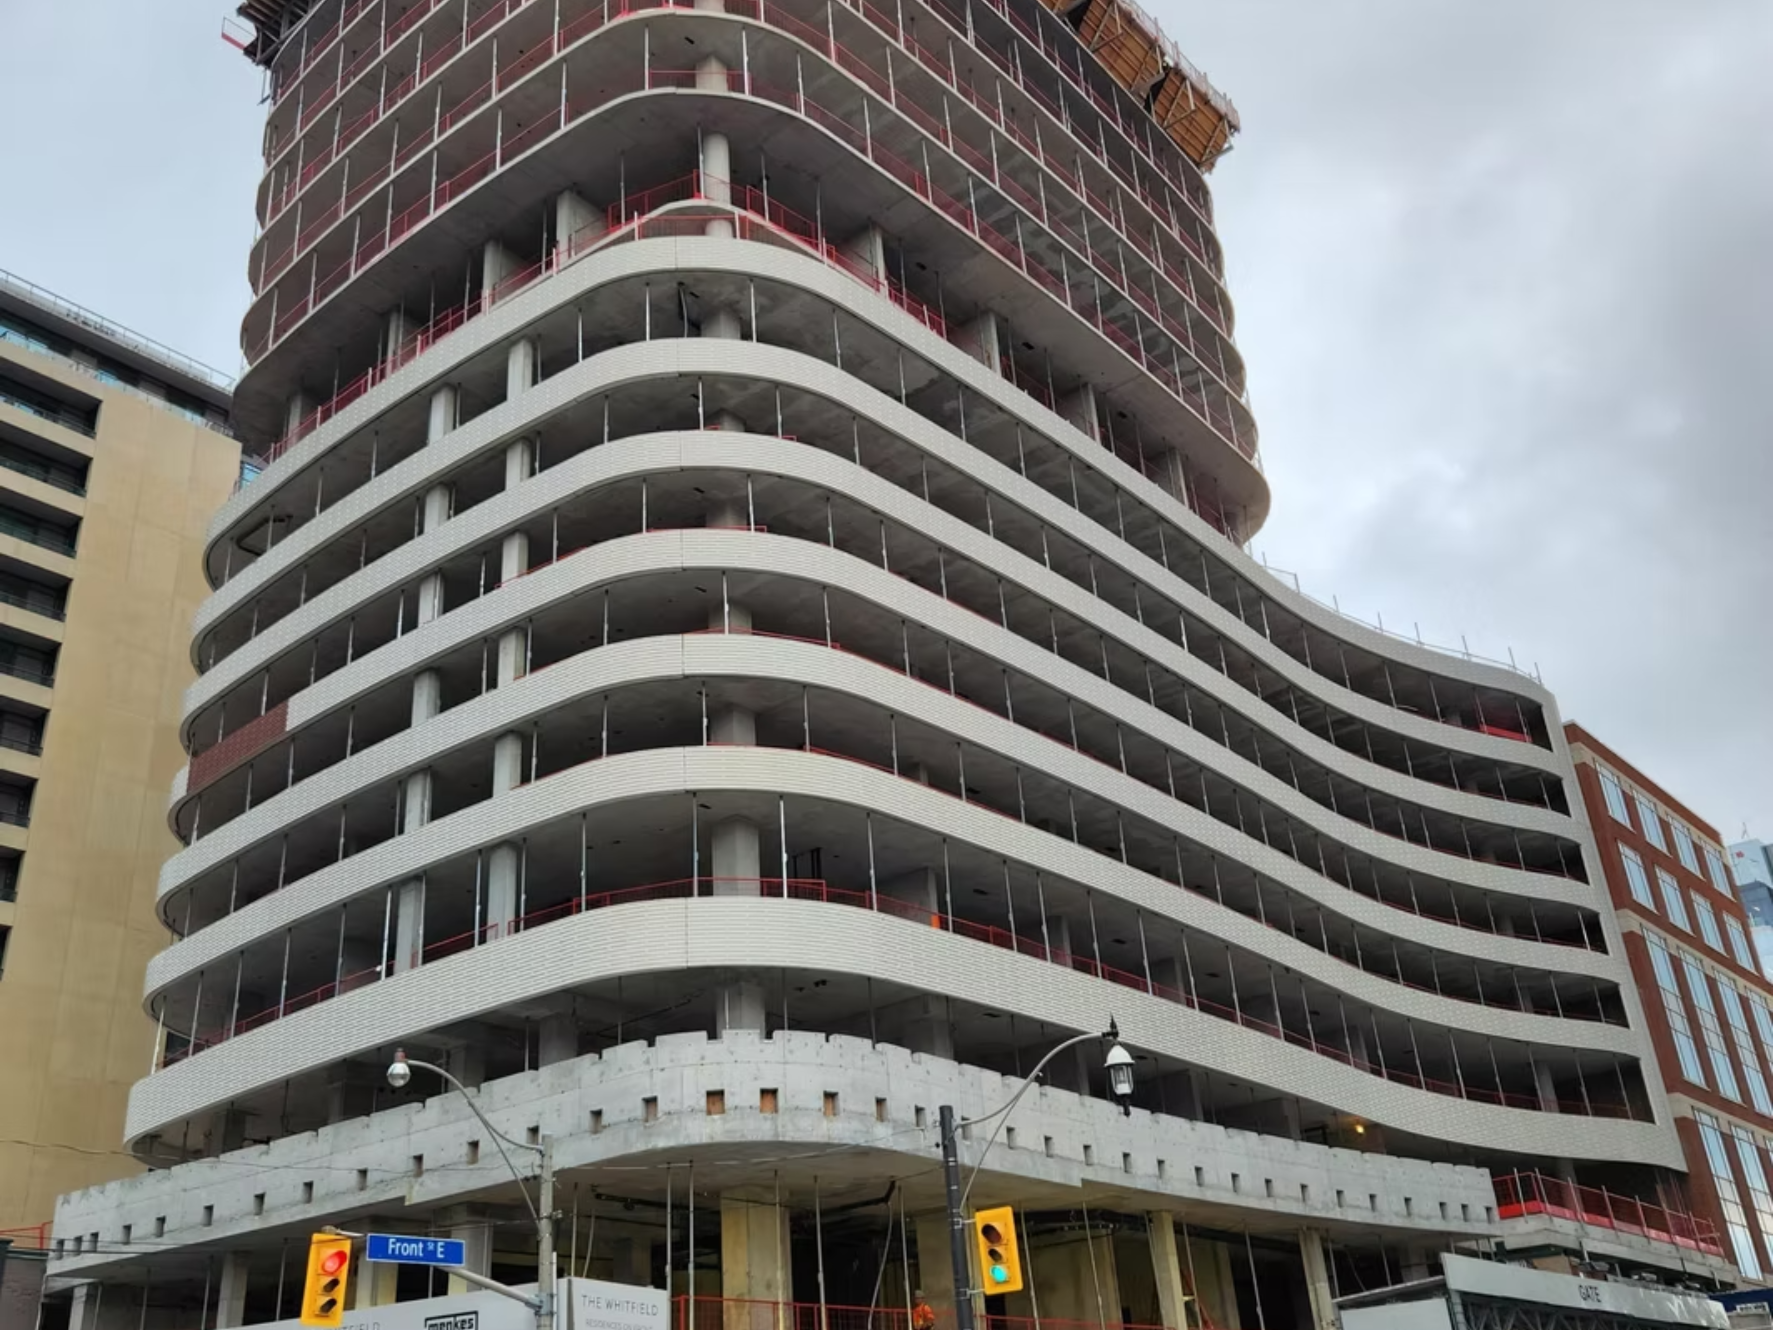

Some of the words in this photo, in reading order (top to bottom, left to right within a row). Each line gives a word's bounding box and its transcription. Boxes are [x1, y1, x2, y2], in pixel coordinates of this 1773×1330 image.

[388, 1238, 424, 1257] Front
[437, 1241, 445, 1258] E
[1578, 1284, 1601, 1303] GATE
[582, 1294, 602, 1309] THE
[605, 1299, 659, 1317] WHITFIELD
